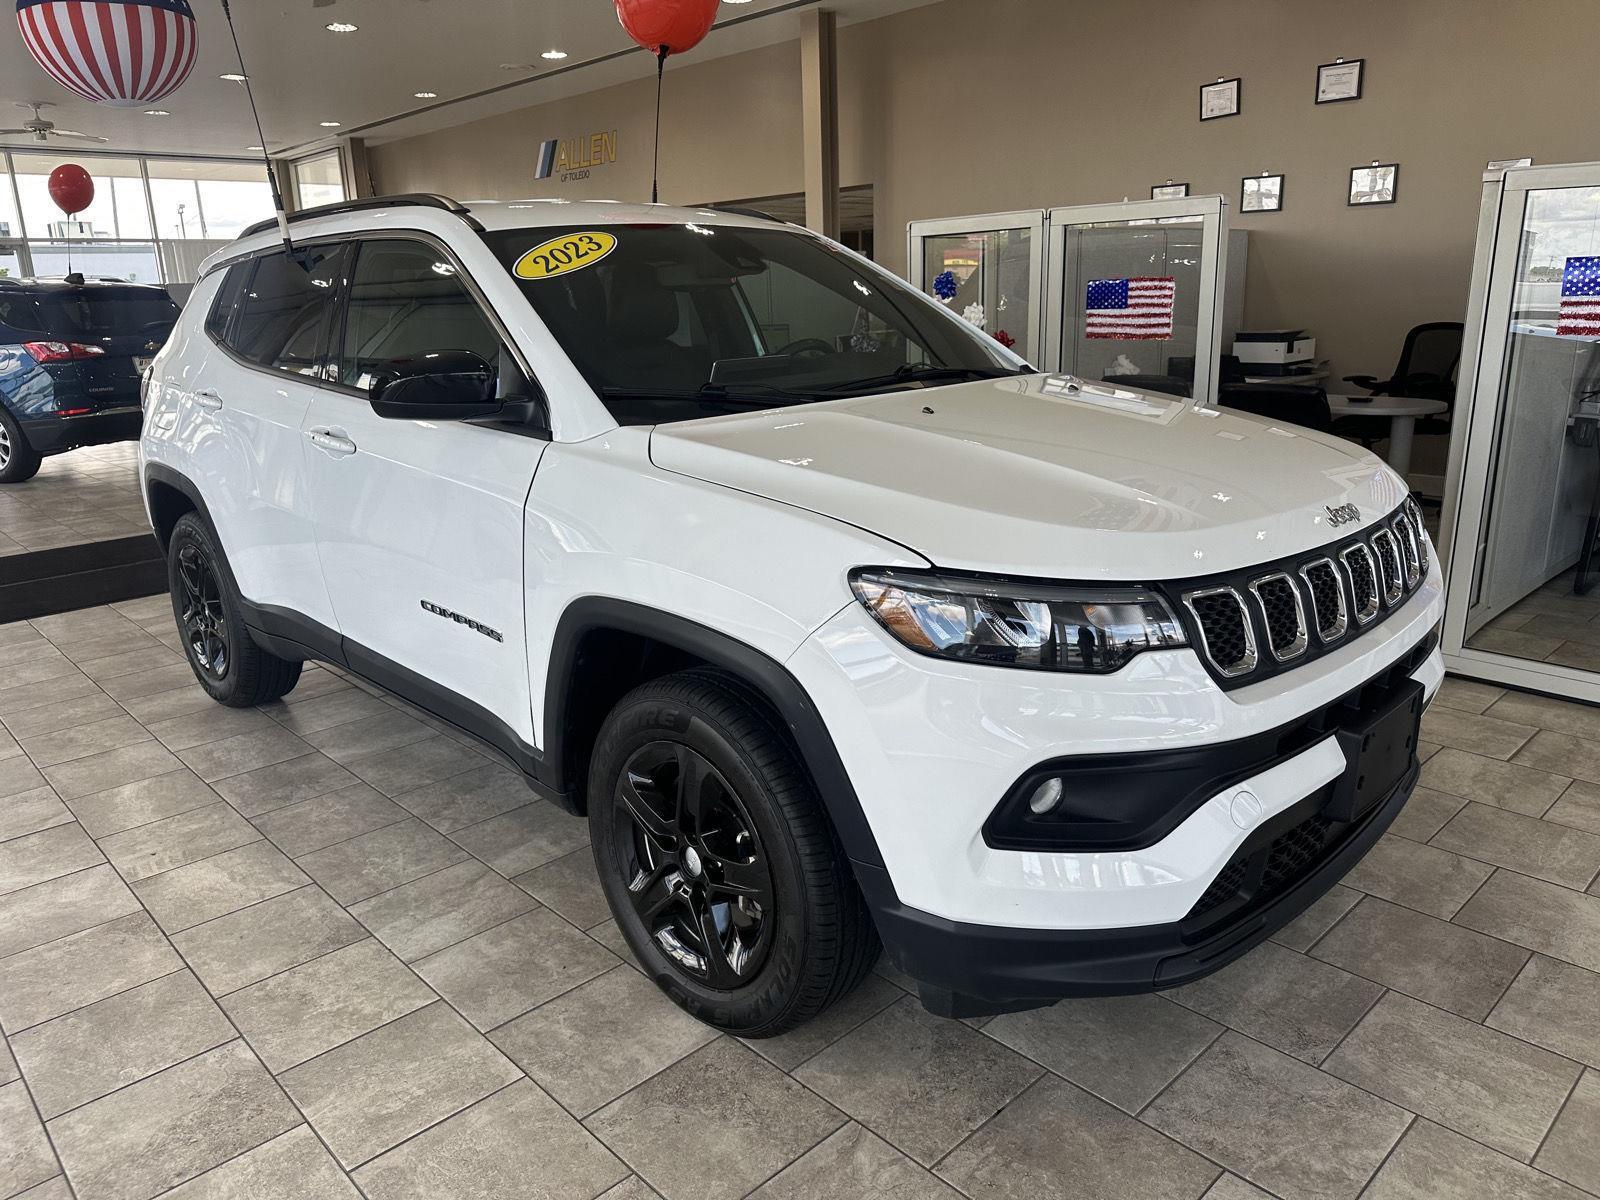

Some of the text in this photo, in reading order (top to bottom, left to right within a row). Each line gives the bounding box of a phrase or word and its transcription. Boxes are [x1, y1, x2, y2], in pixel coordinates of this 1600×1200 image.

[555, 130, 617, 172] ALLEN
[560, 170, 590, 182] OF TOLEDO
[532, 235, 602, 274] 2023
[1324, 503, 1361, 528] Jeep
[420, 599, 503, 643] COMPASS
